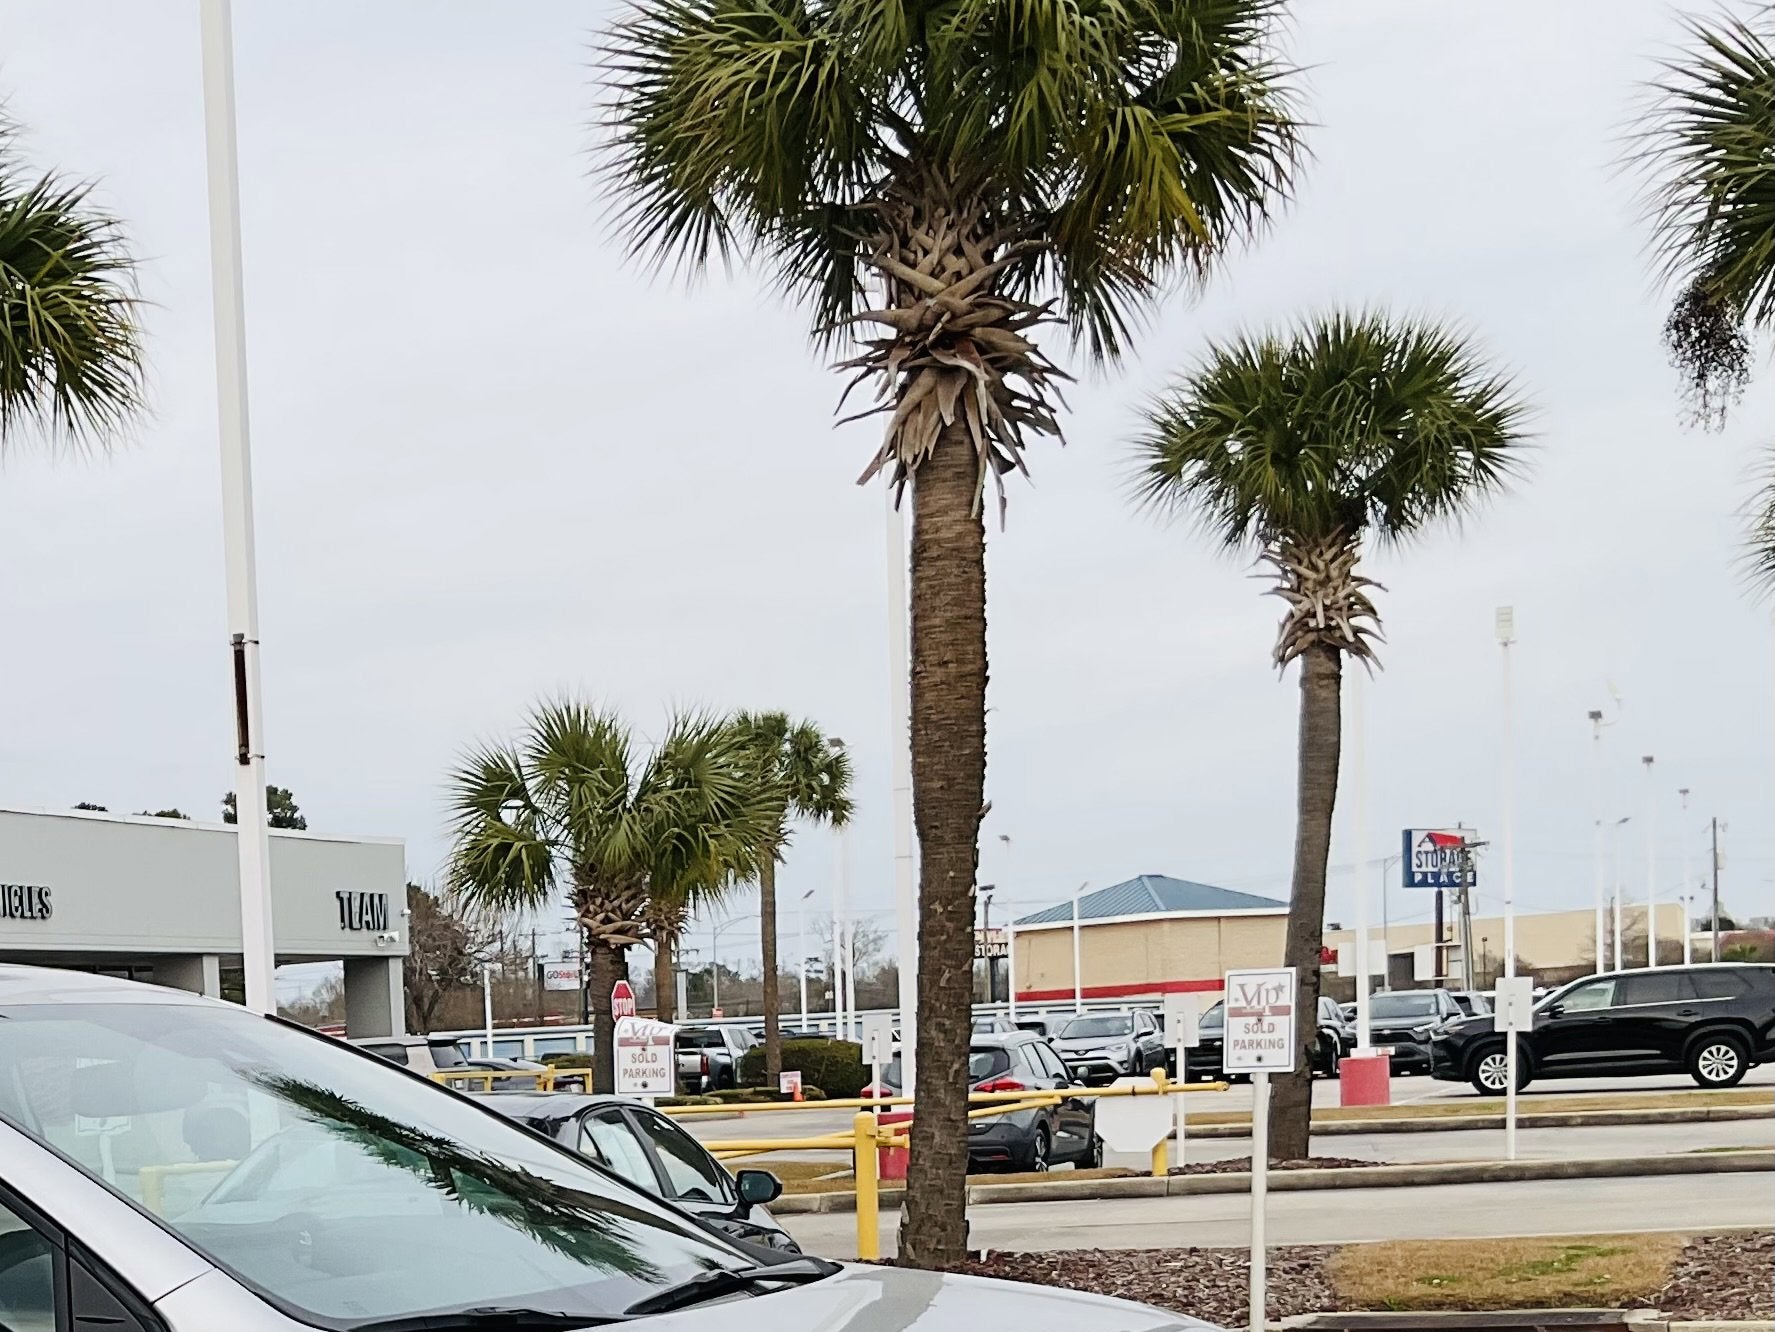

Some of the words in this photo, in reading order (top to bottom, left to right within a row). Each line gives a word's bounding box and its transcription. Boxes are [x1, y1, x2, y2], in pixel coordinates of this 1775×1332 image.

[1414, 873, 1473, 883] PLACE
[335, 890, 389, 930] TEAM
[614, 998, 634, 1016] STOP
[1244, 1022, 1275, 1034] SOLD
[1233, 1039, 1285, 1050] PARKING
[632, 1053, 658, 1064] SOLD
[623, 1067, 666, 1079] PARKING
